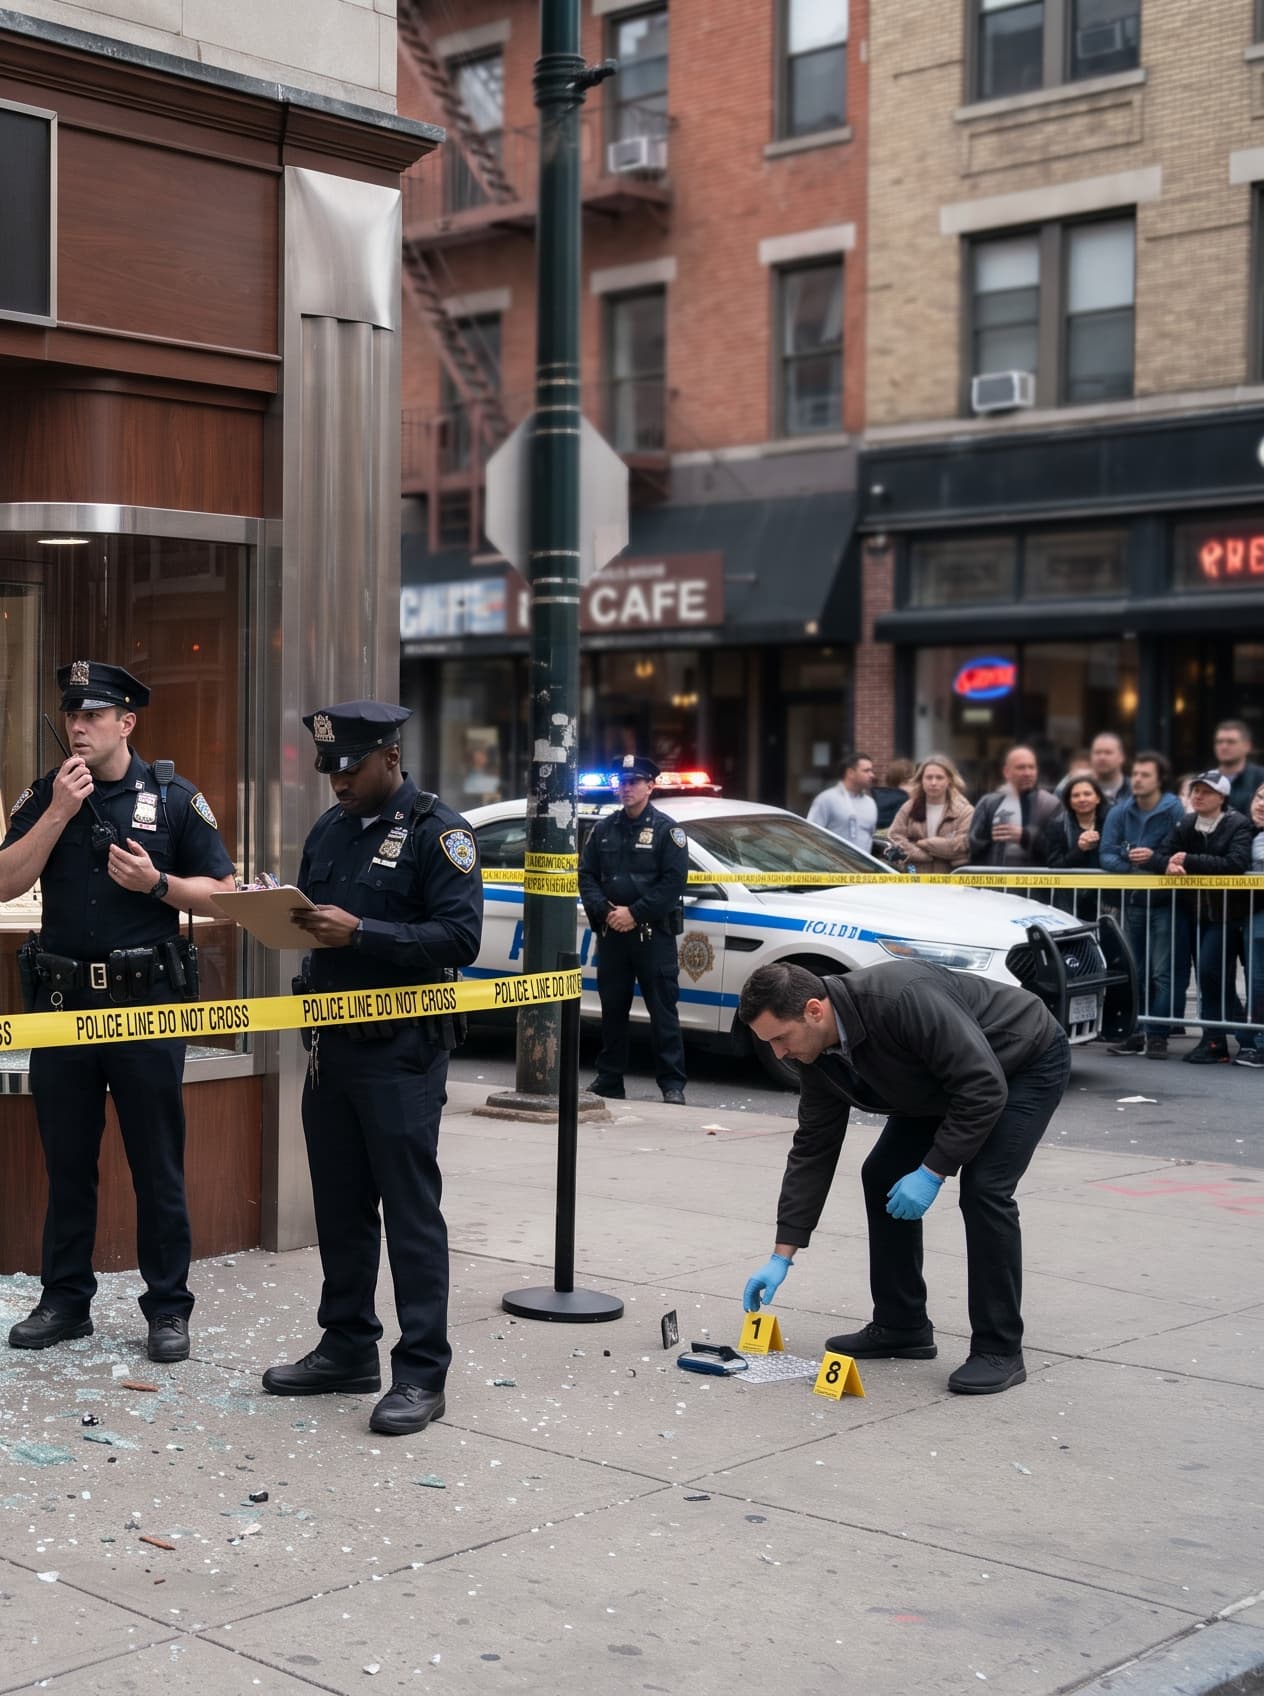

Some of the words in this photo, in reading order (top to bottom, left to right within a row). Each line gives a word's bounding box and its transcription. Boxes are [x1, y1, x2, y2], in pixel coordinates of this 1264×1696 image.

[589, 581, 707, 624] CAFE
[303, 996, 344, 1023] POLICE
[348, 994, 373, 1019] LINE
[377, 991, 392, 1016] DO
[396, 989, 418, 1015] NOT
[421, 987, 457, 1012] CROSS
[494, 980, 529, 1004] POLICE
[531, 978, 551, 1000] LINE
[552, 976, 564, 997] DO
[76, 1013, 122, 1040] POLICE
[126, 1011, 154, 1037] LINE
[158, 1009, 177, 1034] DO
[181, 1007, 205, 1032] NOT
[208, 1004, 249, 1030] CROSS
[751, 1317, 762, 1340] 1
[825, 1360, 841, 1384] 8
